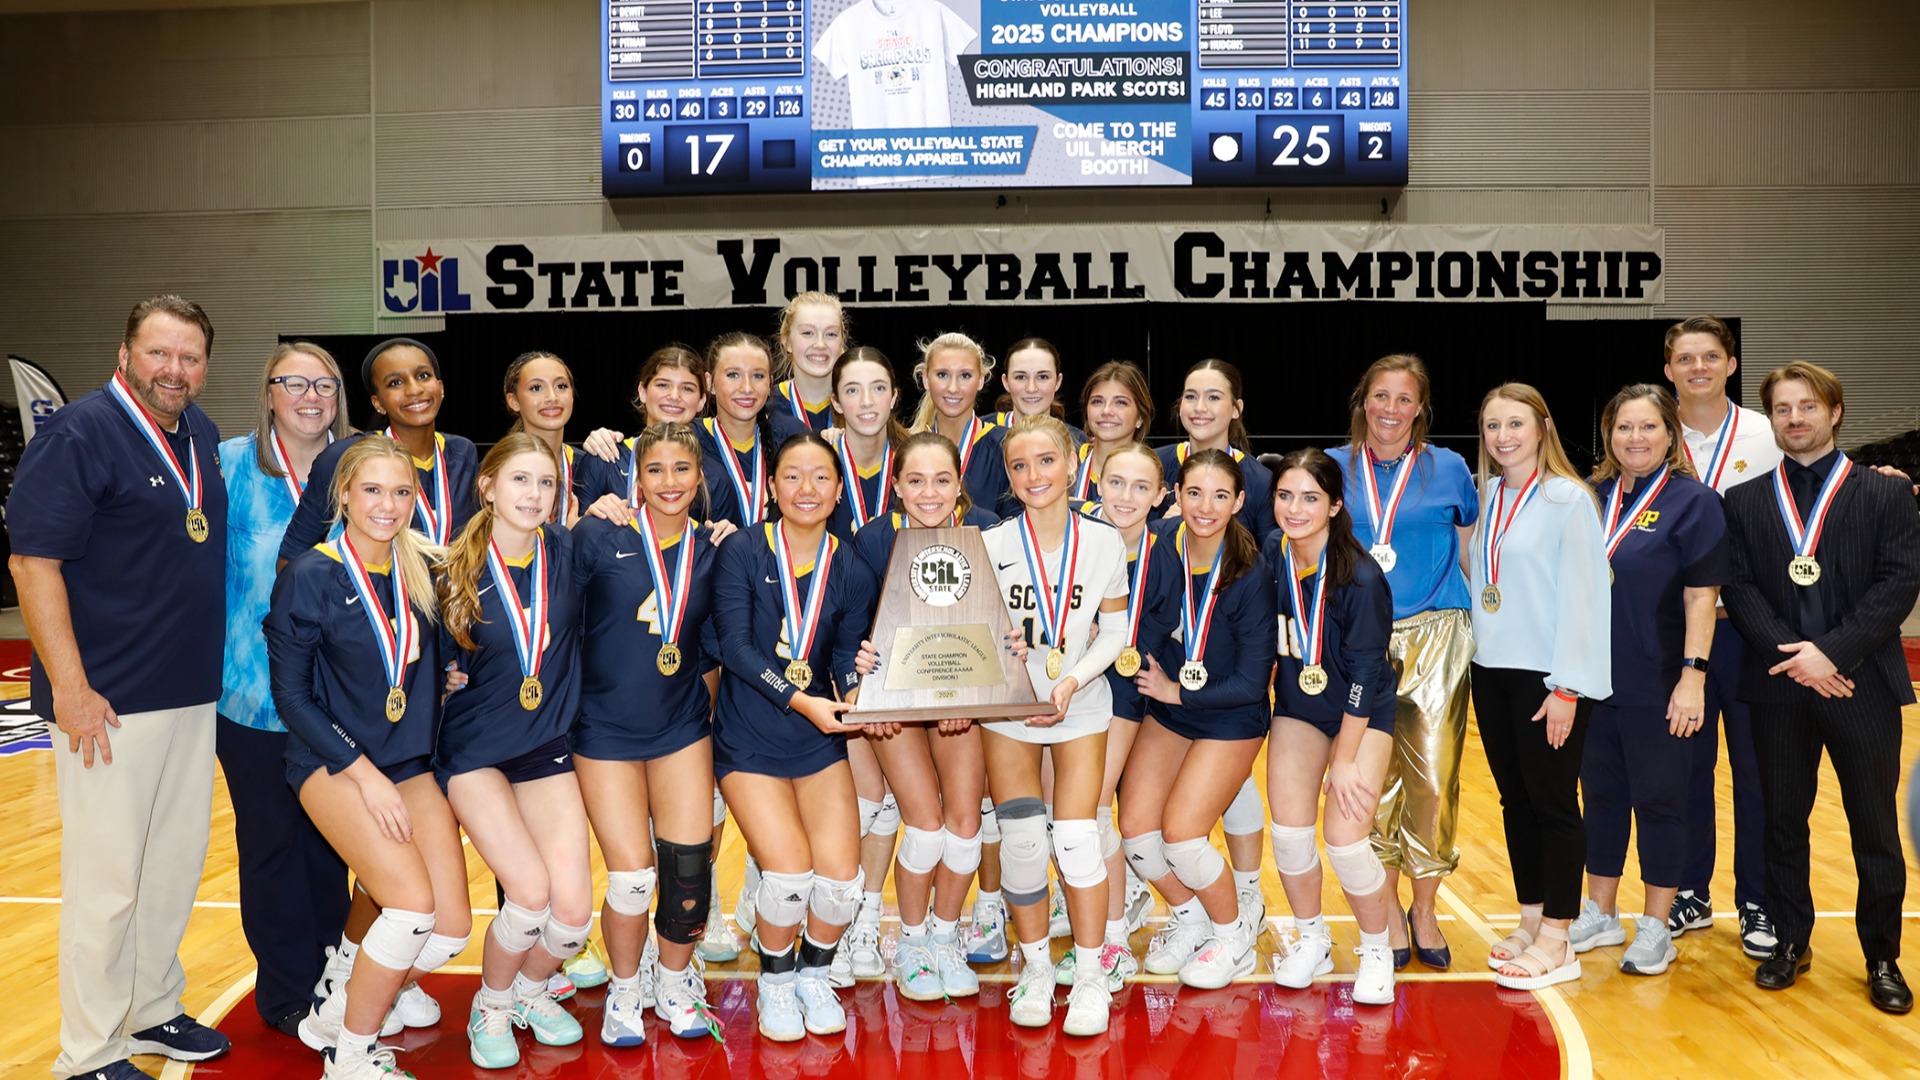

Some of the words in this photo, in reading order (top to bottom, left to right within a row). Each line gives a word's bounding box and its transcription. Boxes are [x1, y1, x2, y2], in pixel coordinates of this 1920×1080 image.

[706, 2, 714, 13] 4
[734, 2, 742, 12] 0
[762, 1, 768, 12] 1
[786, 0, 794, 11] 0
[1040, 4, 1138, 16] VOLLEYBALL
[1210, 8, 1222, 18] LEE
[1300, 7, 1307, 18] 0
[1328, 7, 1336, 18] 0
[1354, 6, 1366, 18] 10
[1382, 6, 1390, 18] 0
[706, 18, 714, 30] 8
[736, 18, 740, 28] 1
[760, 17, 768, 28] 5
[789, 16, 794, 27] 1
[1210, 24, 1234, 34] FLOYD
[1298, 23, 1310, 34] 14
[1328, 23, 1336, 33] 2
[1356, 22, 1364, 33] 5
[1385, 22, 1390, 32] 1
[706, 34, 714, 44] 0
[733, 33, 742, 44] 0
[762, 32, 767, 42] 1
[786, 32, 794, 42] 0
[991, 24, 1045, 44] 2025
[1050, 22, 1184, 43] CHAMPIONS
[1299, 38, 1309, 49] 11
[1328, 38, 1336, 49] 0
[1356, 38, 1364, 48] 9
[1382, 38, 1390, 48] 0
[706, 50, 714, 60] 6
[736, 48, 740, 58] 1
[762, 48, 767, 58] 1
[786, 47, 794, 58] 0
[974, 57, 1183, 78] CONGRATULATIONS!
[976, 82, 1066, 98] HIGHLAND
[1071, 82, 1117, 97] PARK
[1122, 81, 1186, 96] SCOTS!
[1203, 79, 1226, 87] KILLS
[1238, 78, 1260, 86] BLKS
[1272, 78, 1295, 86] DIGS
[1304, 78, 1328, 86] ACES
[1339, 78, 1362, 86] ASTS
[1372, 78, 1390, 86] ATK
[613, 90, 636, 100] KILLS
[646, 90, 668, 98] BLKS
[678, 88, 702, 98] DIGS
[710, 88, 734, 96] ACES
[744, 86, 766, 96] ASTS
[775, 86, 793, 94] ATK
[1205, 93, 1226, 107] 45
[1237, 92, 1262, 107] 3.0
[1274, 92, 1294, 106] 52
[1312, 92, 1322, 106] 6
[1341, 92, 1360, 106] 43
[1372, 92, 1394, 106] .248
[615, 105, 634, 120] 30
[646, 104, 670, 118] 4.0
[680, 103, 700, 117] 40
[718, 102, 728, 116] 3
[746, 102, 766, 115] 29
[776, 101, 800, 115] .126
[1052, 122, 1104, 138] COME
[1110, 122, 1134, 138] TO
[1139, 122, 1176, 138] THE
[1359, 122, 1392, 132] TIMEOUTS
[619, 133, 650, 144] TIMEOUTS
[818, 139, 848, 152] GET
[848, 138, 888, 152] YOUR
[890, 136, 978, 150] VOLLEYBALL
[980, 136, 1024, 148] STATE
[1272, 125, 1331, 166] 25
[685, 134, 735, 175] 17
[1066, 141, 1095, 157] UIL
[1100, 140, 1164, 156] MERCH
[1368, 136, 1383, 158] 2
[627, 148, 643, 170] 0
[821, 154, 902, 168] CHAMPIONS
[905, 153, 968, 166] APPAREL
[971, 152, 1020, 165] TODAY!
[1081, 159, 1148, 175] BOOTH!
[383, 257, 471, 312] UIL
[486, 244, 684, 309] STATE
[717, 238, 1146, 305] VOLLEYBALL
[1174, 232, 1662, 299] CHAMPIONSHIP
[922, 561, 959, 584] UIL
[1794, 564, 1814, 576] UIL
[1009, 584, 1084, 610] SCS
[902, 638, 925, 665] UNIVERSITY
[924, 632, 972, 646] INTERSCHOLASTIC
[970, 643, 987, 661] LEAGUE
[760, 668, 788, 693] PRIDE
[1184, 669, 1202, 680] UIL
